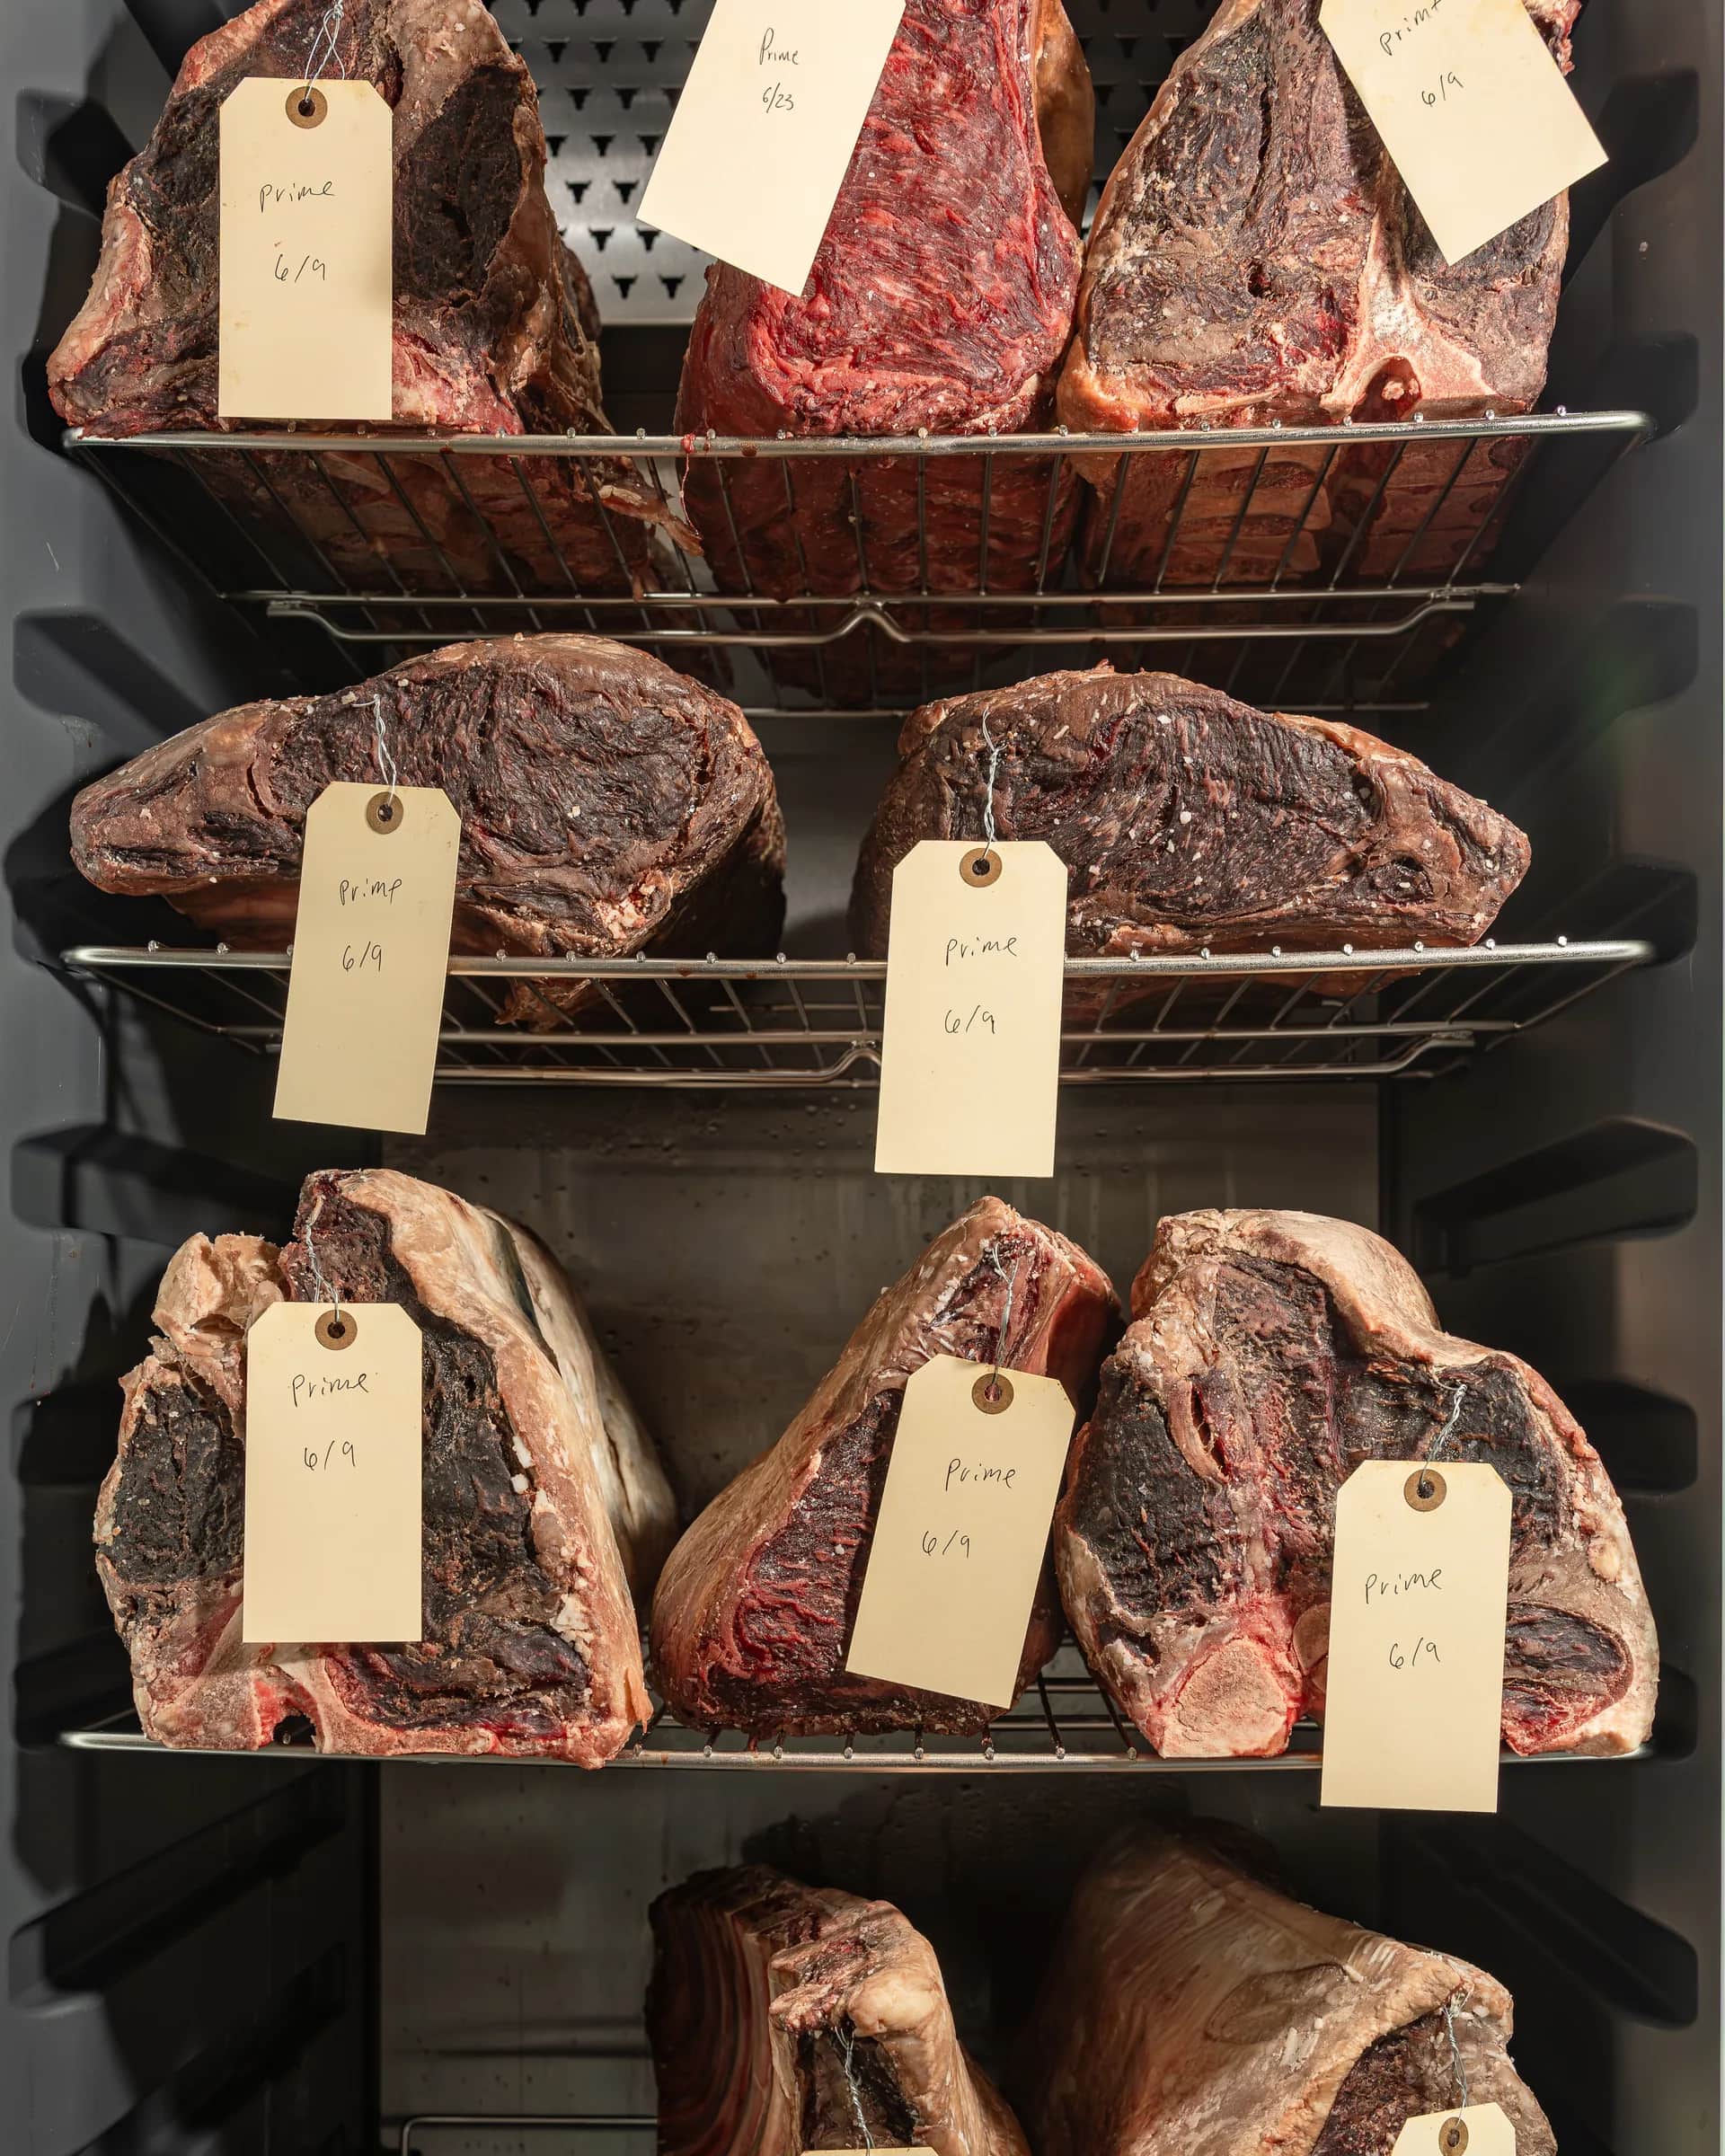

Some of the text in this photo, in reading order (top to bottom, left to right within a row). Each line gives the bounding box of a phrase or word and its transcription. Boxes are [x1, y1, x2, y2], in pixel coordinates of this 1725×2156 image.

[759, 27, 799, 66] Prime
[762, 82, 794, 114] 6/23
[1421, 71, 1464, 108] 6/9
[274, 253, 325, 283] 6/9
[342, 941, 382, 973] 6/9
[944, 1004, 995, 1035] 6/9
[304, 1439, 356, 1471] 6/9
[922, 1530, 970, 1559] 6/9
[1389, 1637, 1441, 1670] 6/9
